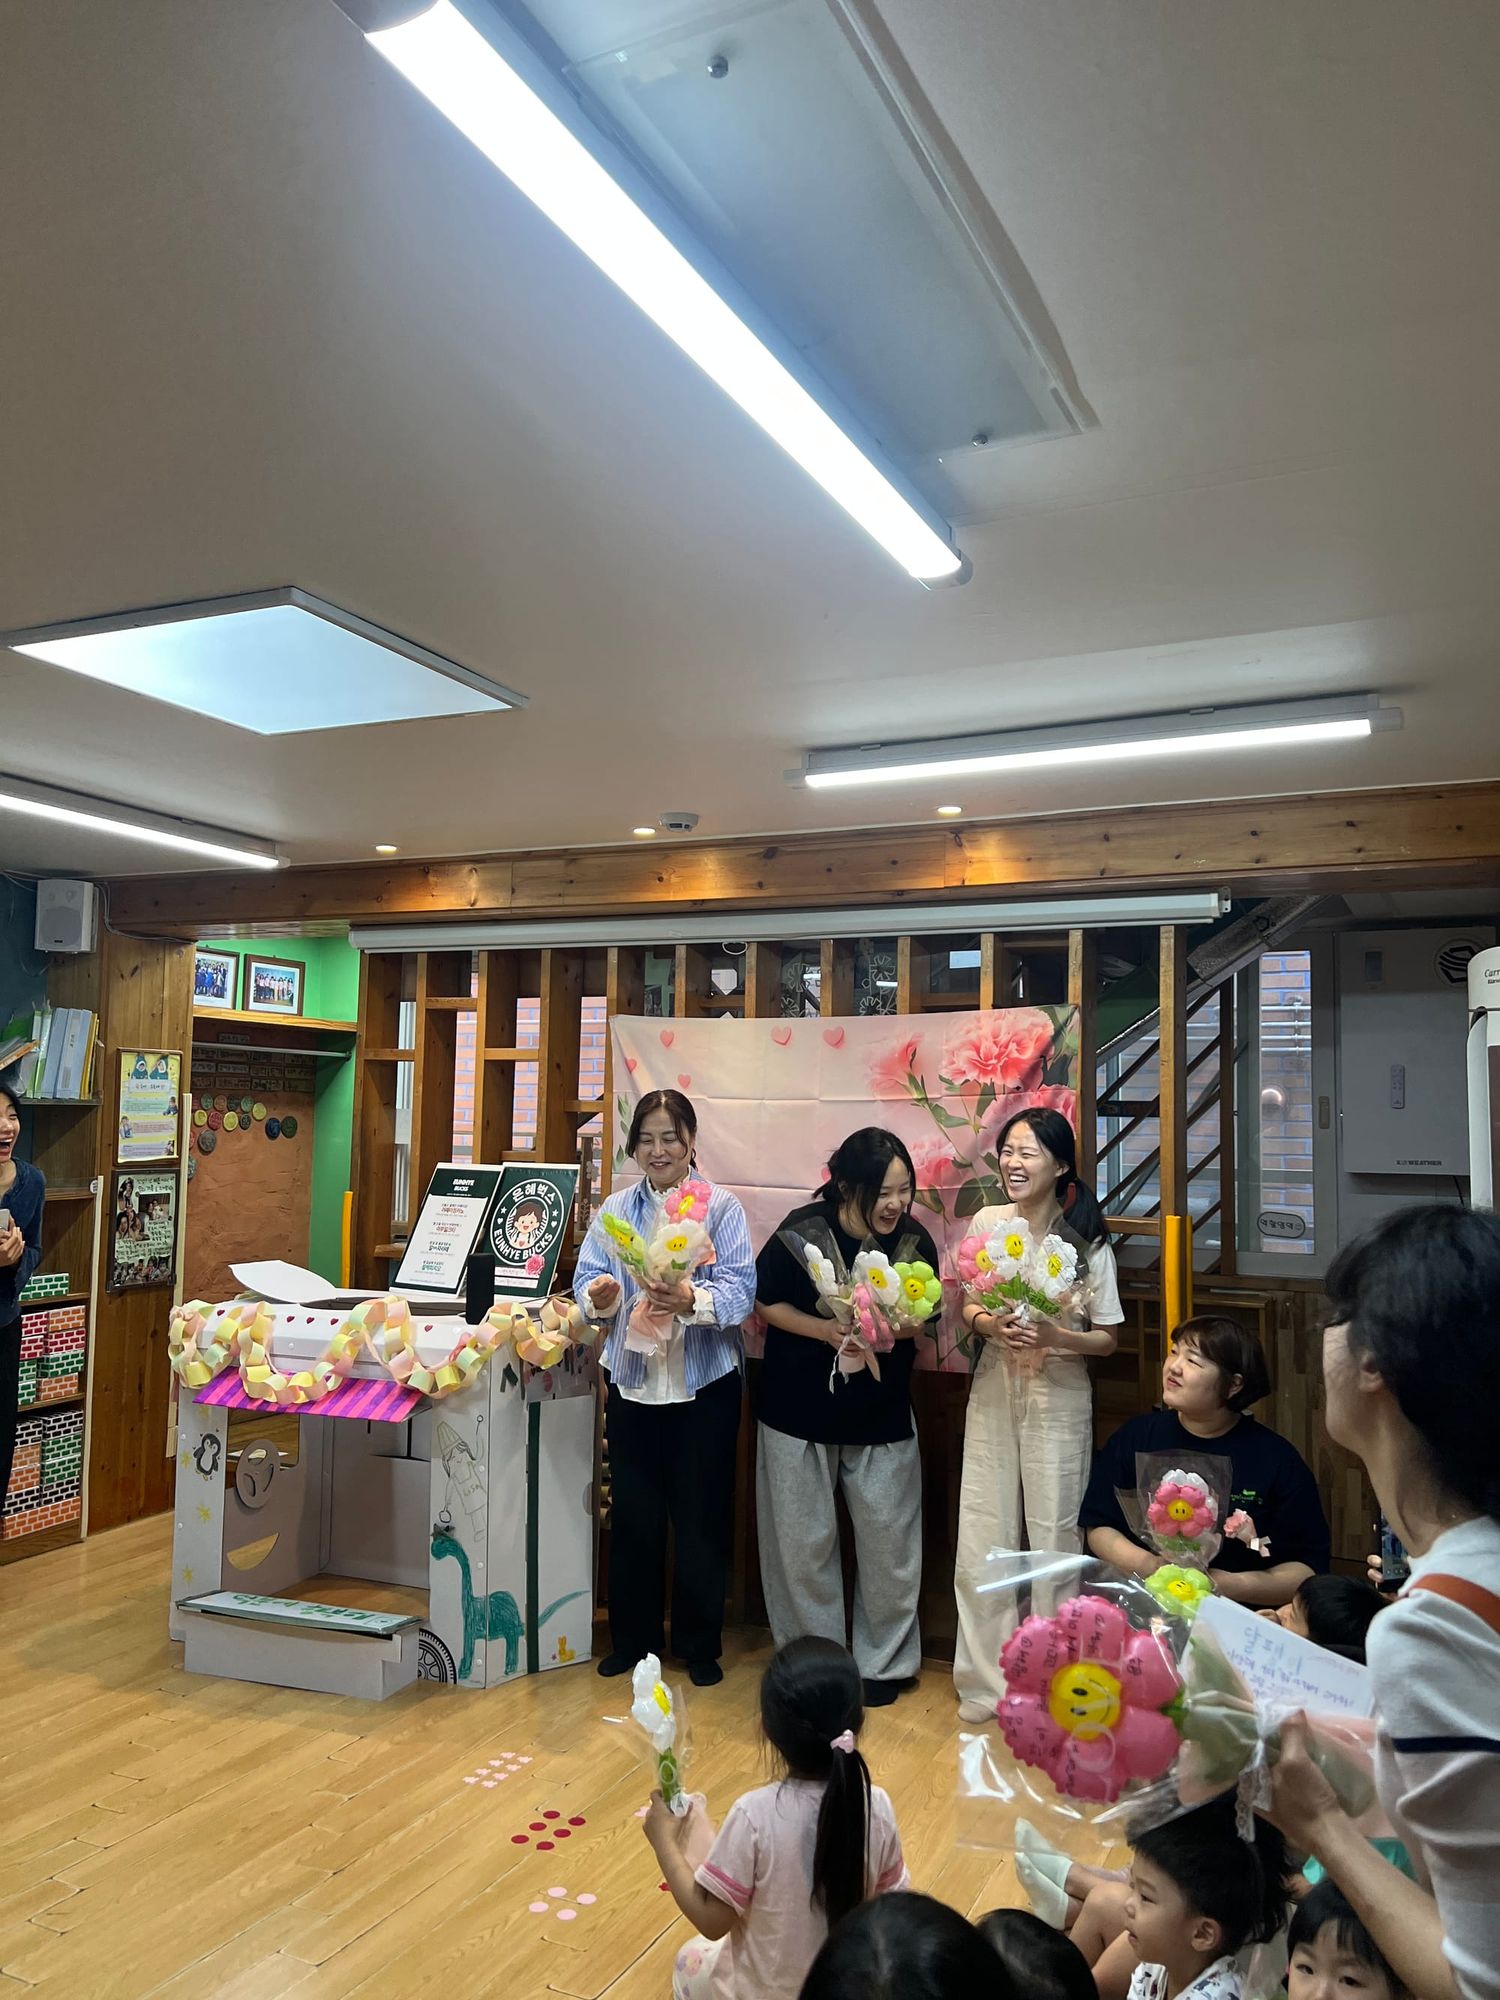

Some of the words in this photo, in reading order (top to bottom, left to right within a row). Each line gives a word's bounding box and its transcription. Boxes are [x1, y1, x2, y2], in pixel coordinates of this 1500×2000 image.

[512, 1183, 555, 1205] 은혜벅스
[494, 1228, 522, 1260] EUNHYE
[522, 1232, 553, 1260] BUCKS
